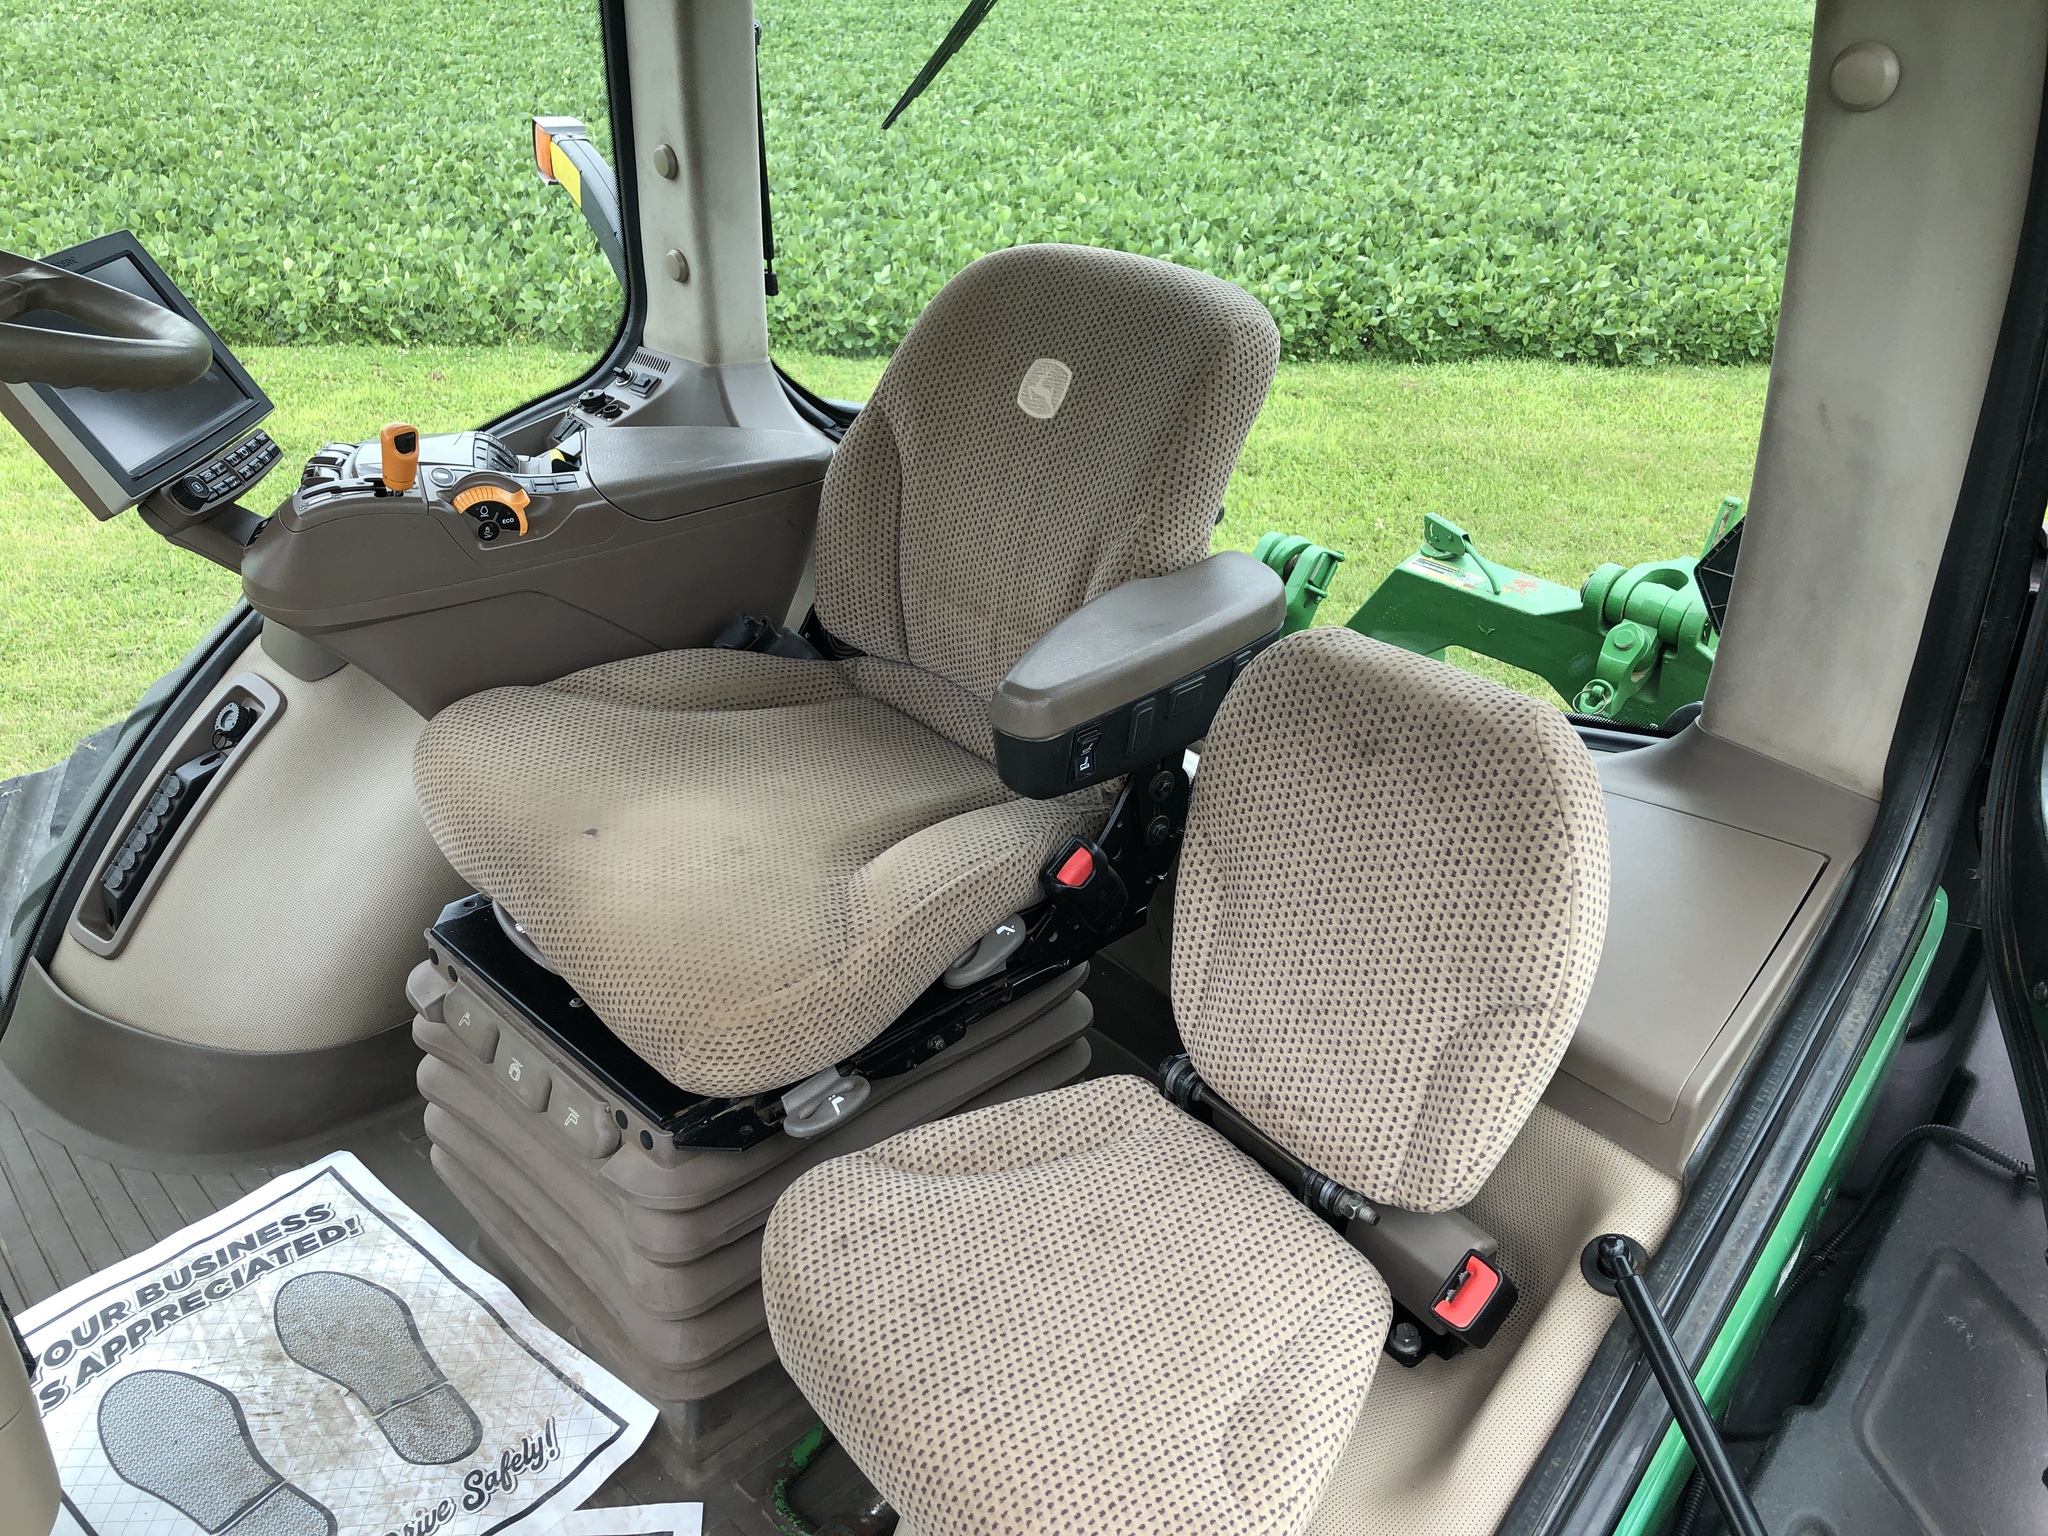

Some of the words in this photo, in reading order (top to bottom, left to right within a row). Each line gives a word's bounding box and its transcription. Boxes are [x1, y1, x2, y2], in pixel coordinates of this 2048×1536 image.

[502, 517, 515, 525] ECO
[74, 1216, 363, 1390] APPRECIATED!
[135, 1203, 333, 1307] BUSINESS
[384, 1498, 454, 1536] rive
[462, 1416, 559, 1512] Safely!
